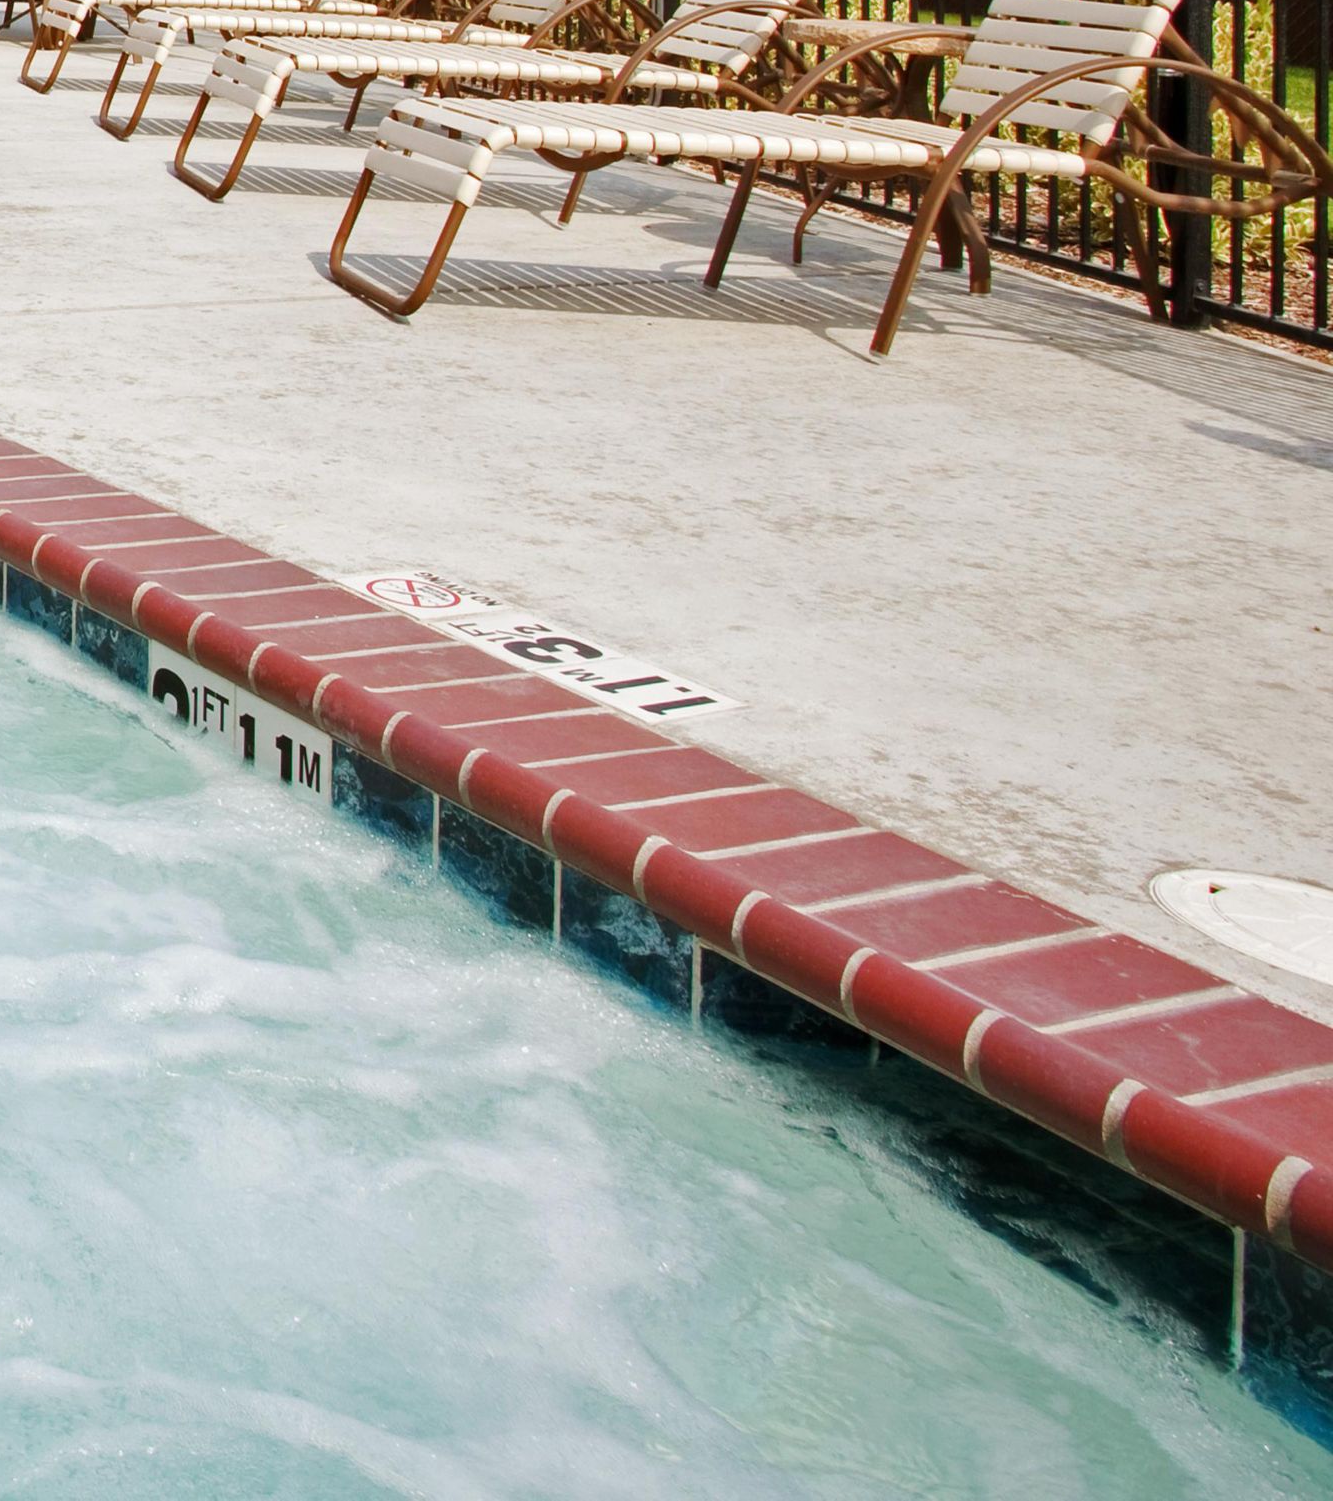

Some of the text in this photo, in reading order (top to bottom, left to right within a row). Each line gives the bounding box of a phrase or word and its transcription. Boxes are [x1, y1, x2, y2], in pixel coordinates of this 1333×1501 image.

[413, 571, 477, 596] DIVING
[471, 594, 504, 607] NO
[448, 622, 497, 638] FT
[203, 685, 230, 733] FT
[298, 743, 321, 794] M
